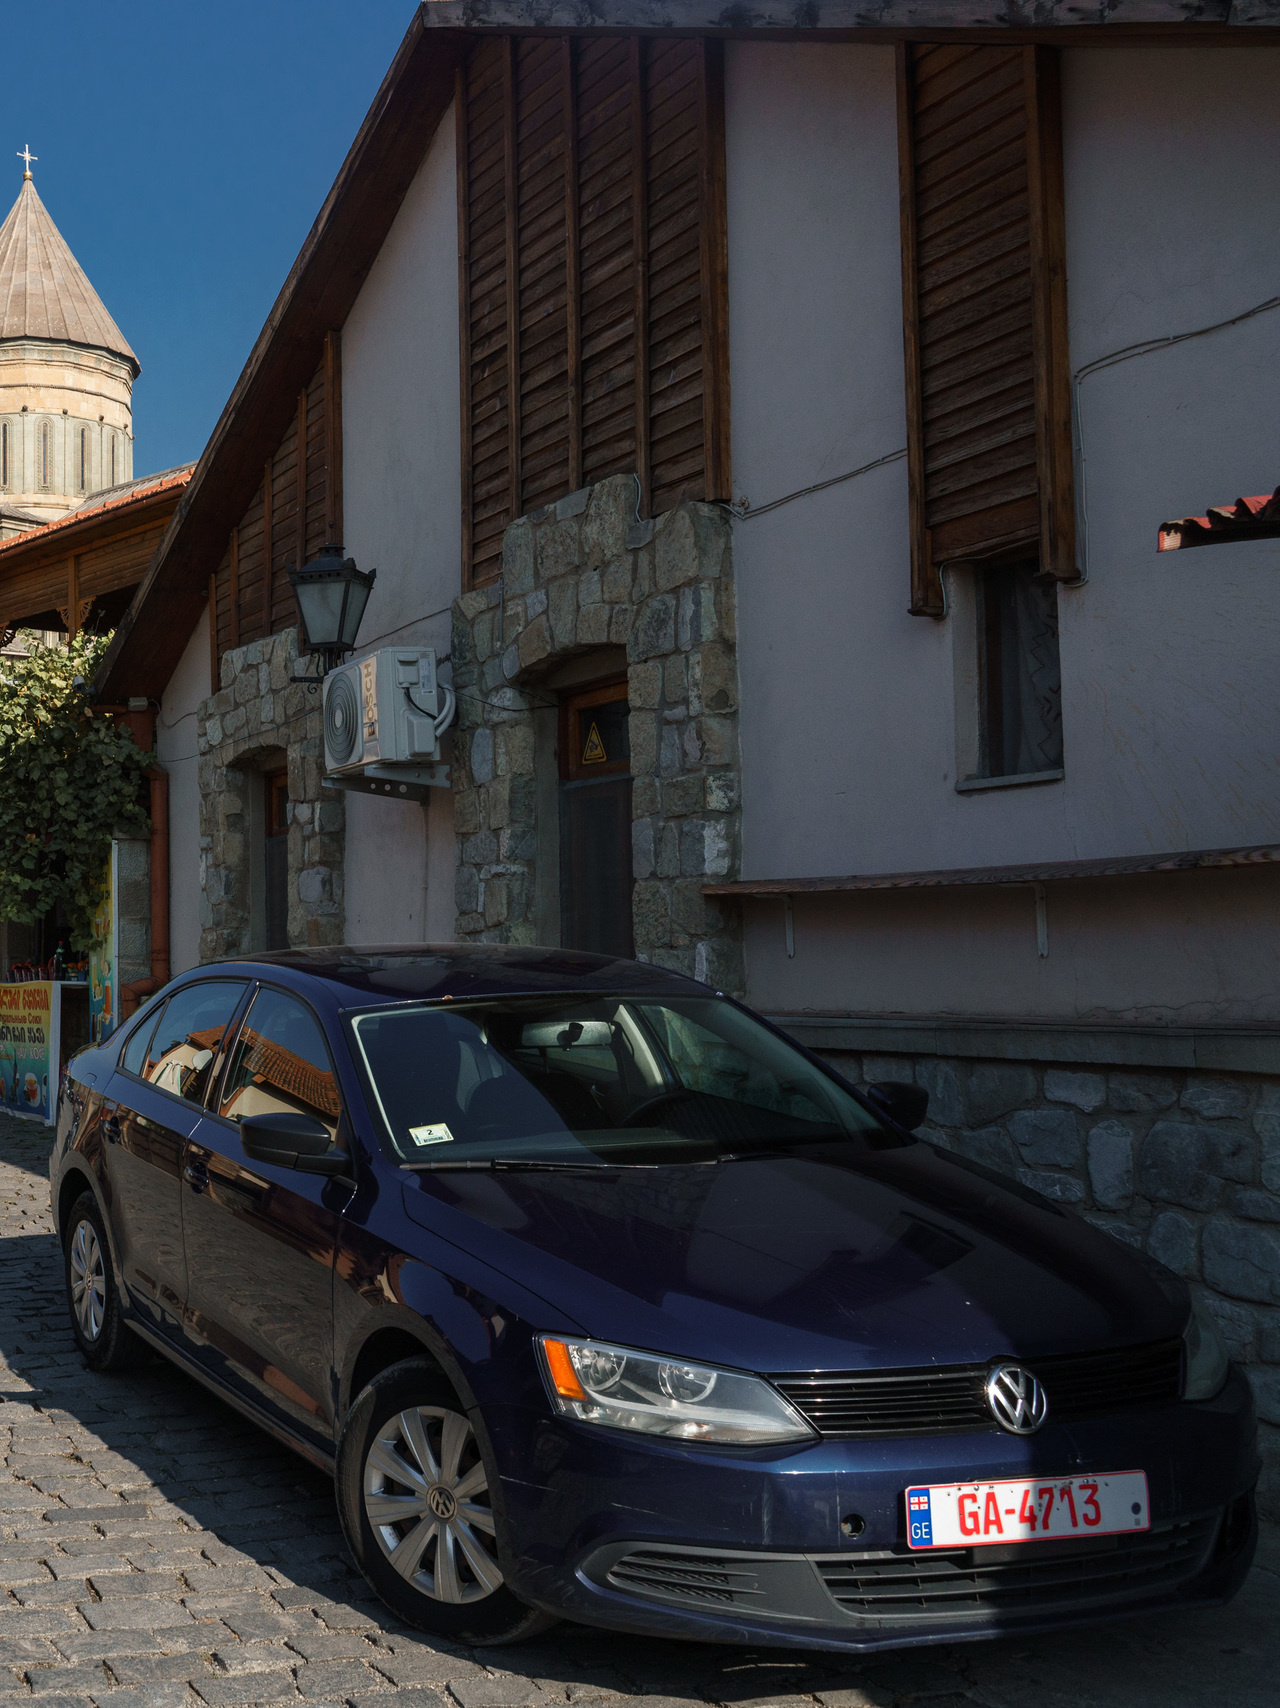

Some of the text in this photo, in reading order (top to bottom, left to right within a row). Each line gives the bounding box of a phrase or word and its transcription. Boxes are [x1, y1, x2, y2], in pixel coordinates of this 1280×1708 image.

[364, 662, 375, 737] BOSCH
[911, 1522, 931, 1539] GE
[958, 1484, 1102, 1536] GA-4713
